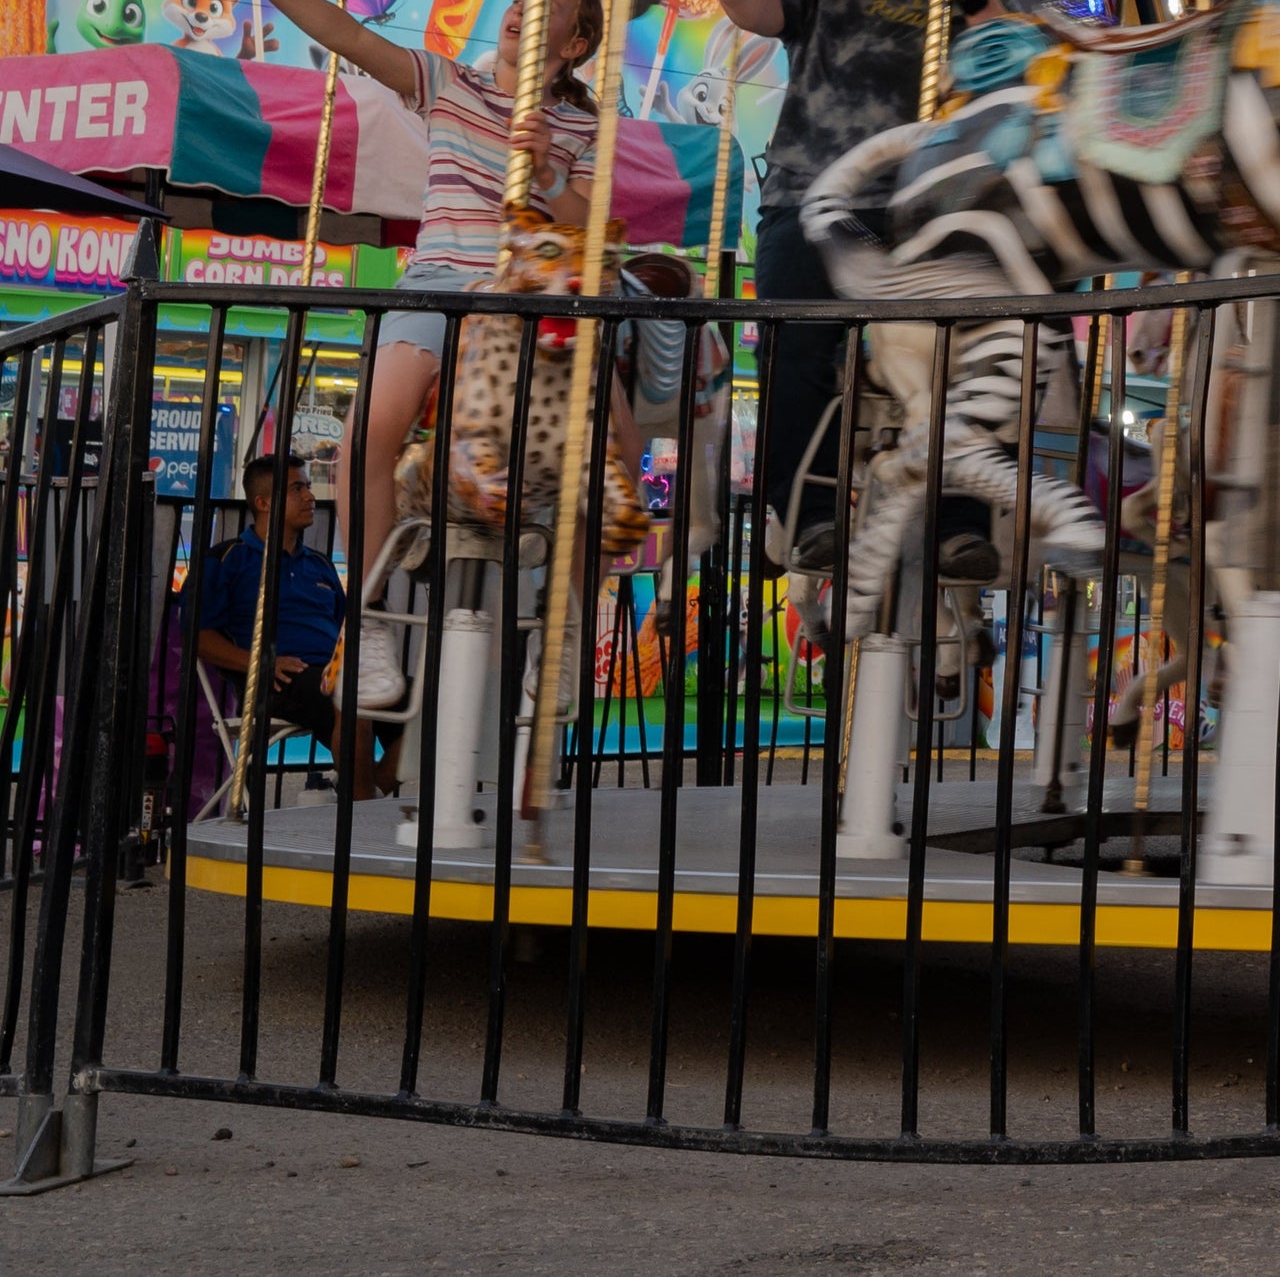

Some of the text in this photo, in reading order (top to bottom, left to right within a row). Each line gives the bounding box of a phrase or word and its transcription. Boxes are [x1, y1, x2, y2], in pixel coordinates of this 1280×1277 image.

[0, 80, 149, 143] NTER
[0, 220, 53, 272] NO
[208, 236, 327, 266] JUMBO
[185, 260, 264, 285] CORN
[151, 409, 223, 430] PROUDY
[167, 461, 198, 480] pep
